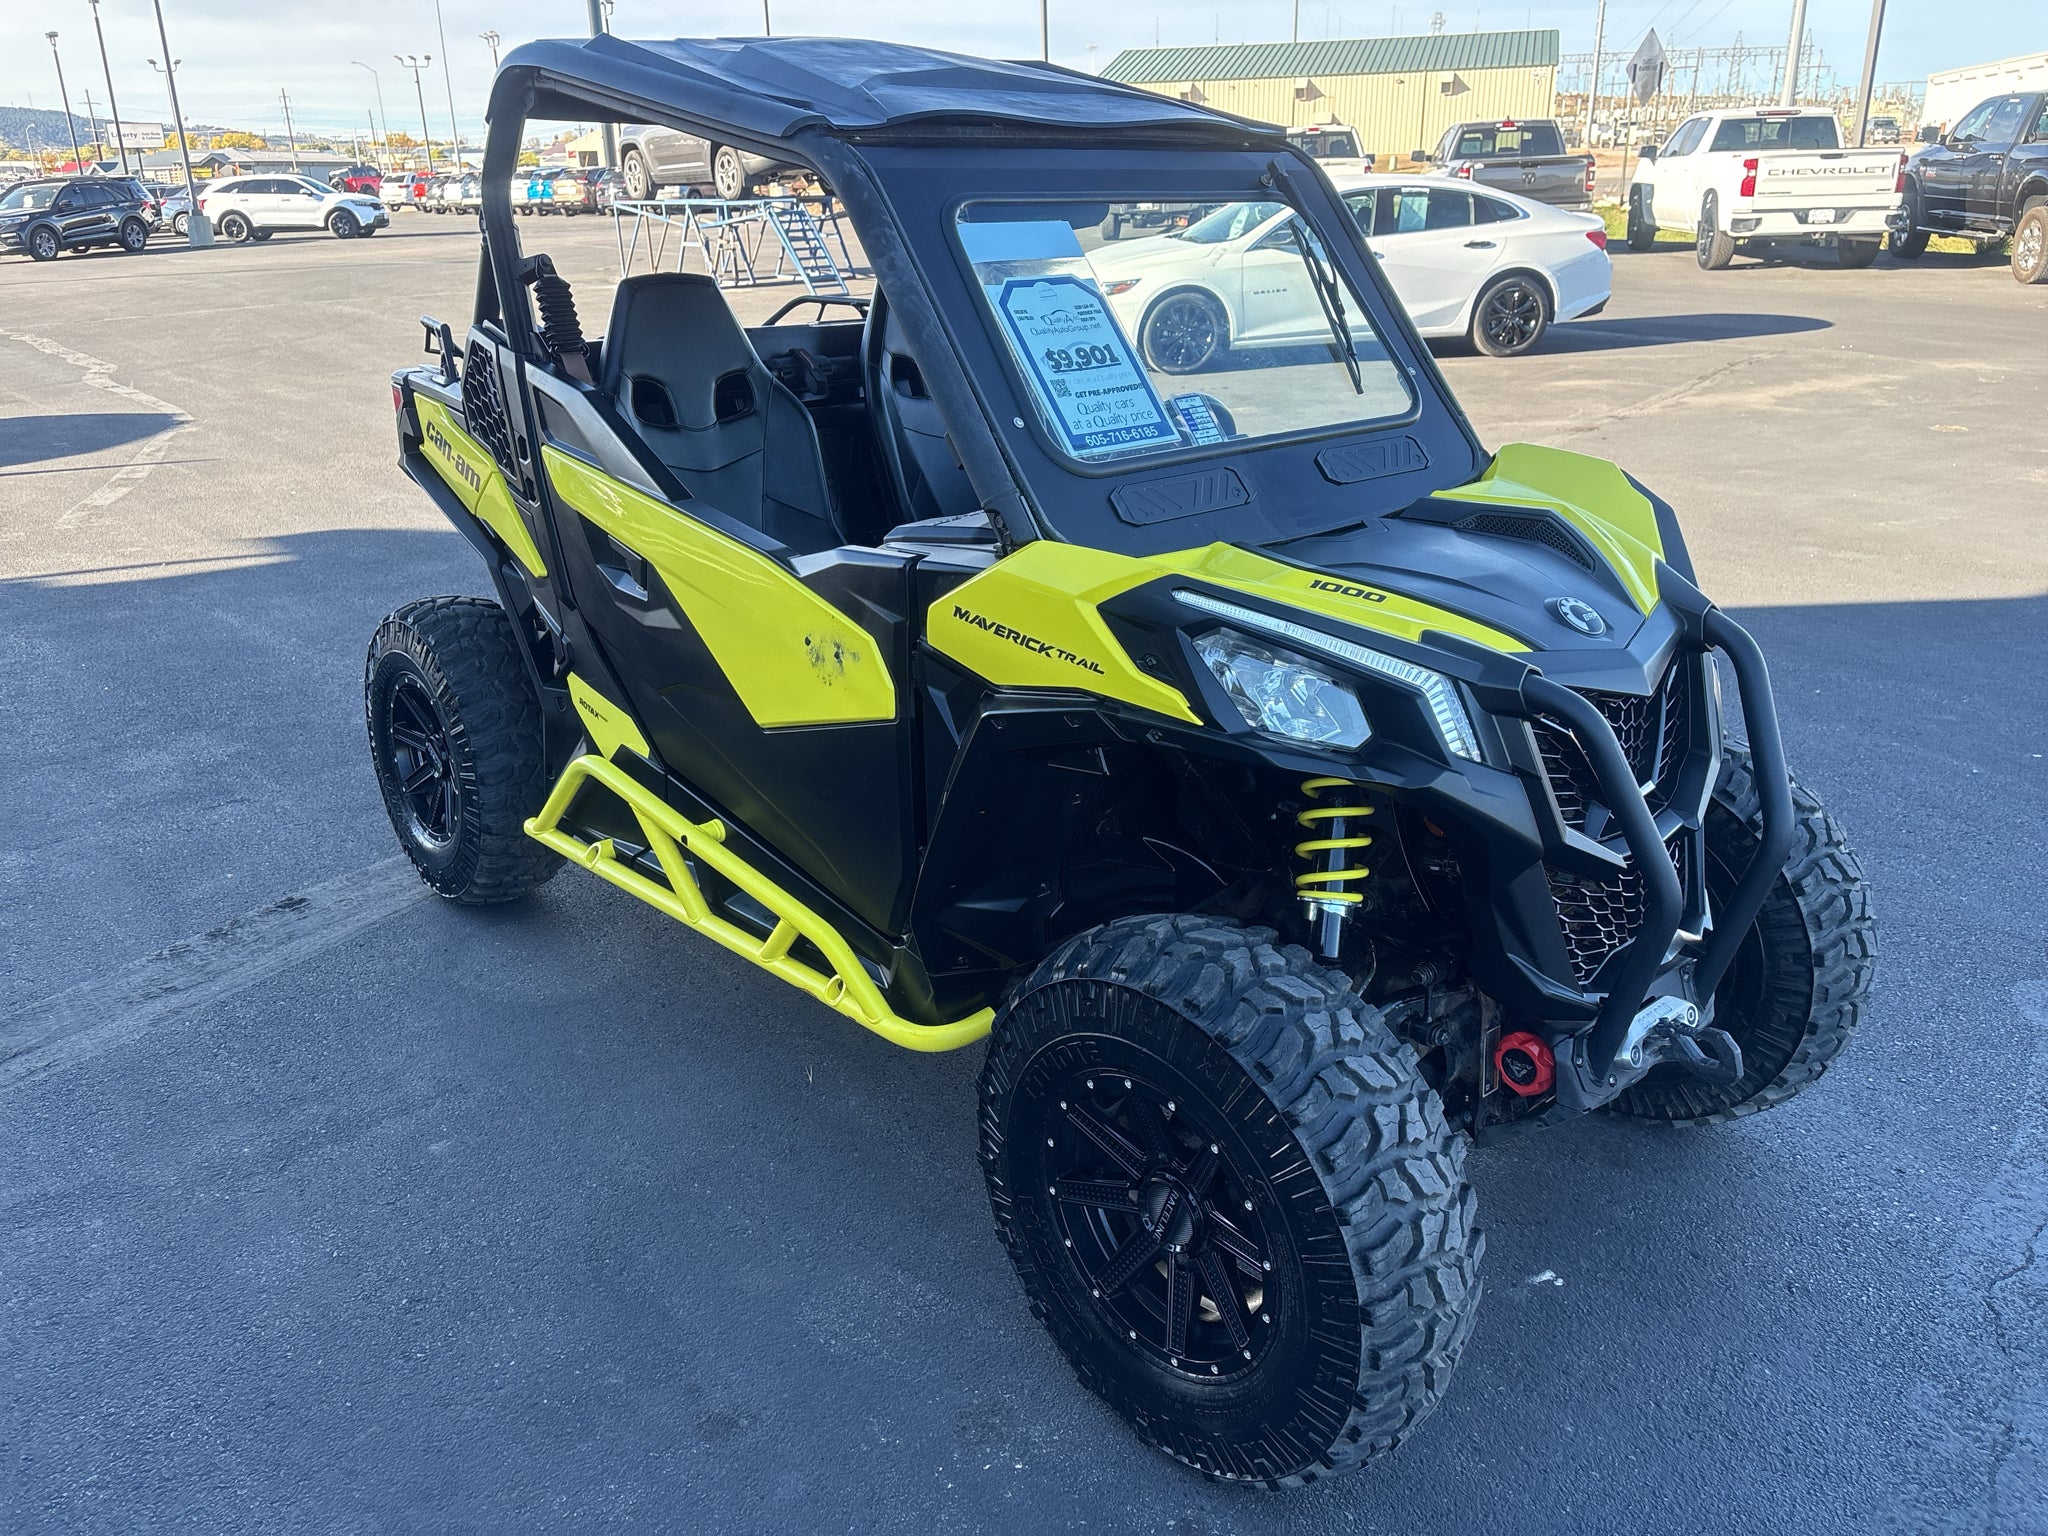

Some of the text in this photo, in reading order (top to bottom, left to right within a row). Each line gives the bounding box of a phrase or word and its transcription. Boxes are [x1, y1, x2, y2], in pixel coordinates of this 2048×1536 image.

[111, 131, 138, 139] Lerty
[1768, 166, 1889, 176] CHEVROLET
[1030, 322, 1102, 336] QualityAutoGroup.net
[1045, 344, 1120, 371] $9,901
[1077, 398, 1135, 415] Quality cars
[1073, 420, 1082, 430] at
[1093, 412, 1128, 428] Quality
[1132, 409, 1154, 424] price
[1085, 425, 1158, 447] 605-716-6185
[1309, 579, 1387, 603] 1000
[953, 605, 1105, 675] MAVERICK TRAIL
[579, 697, 600, 720] ROTAX
[1153, 1189, 1180, 1240] RACELINE
